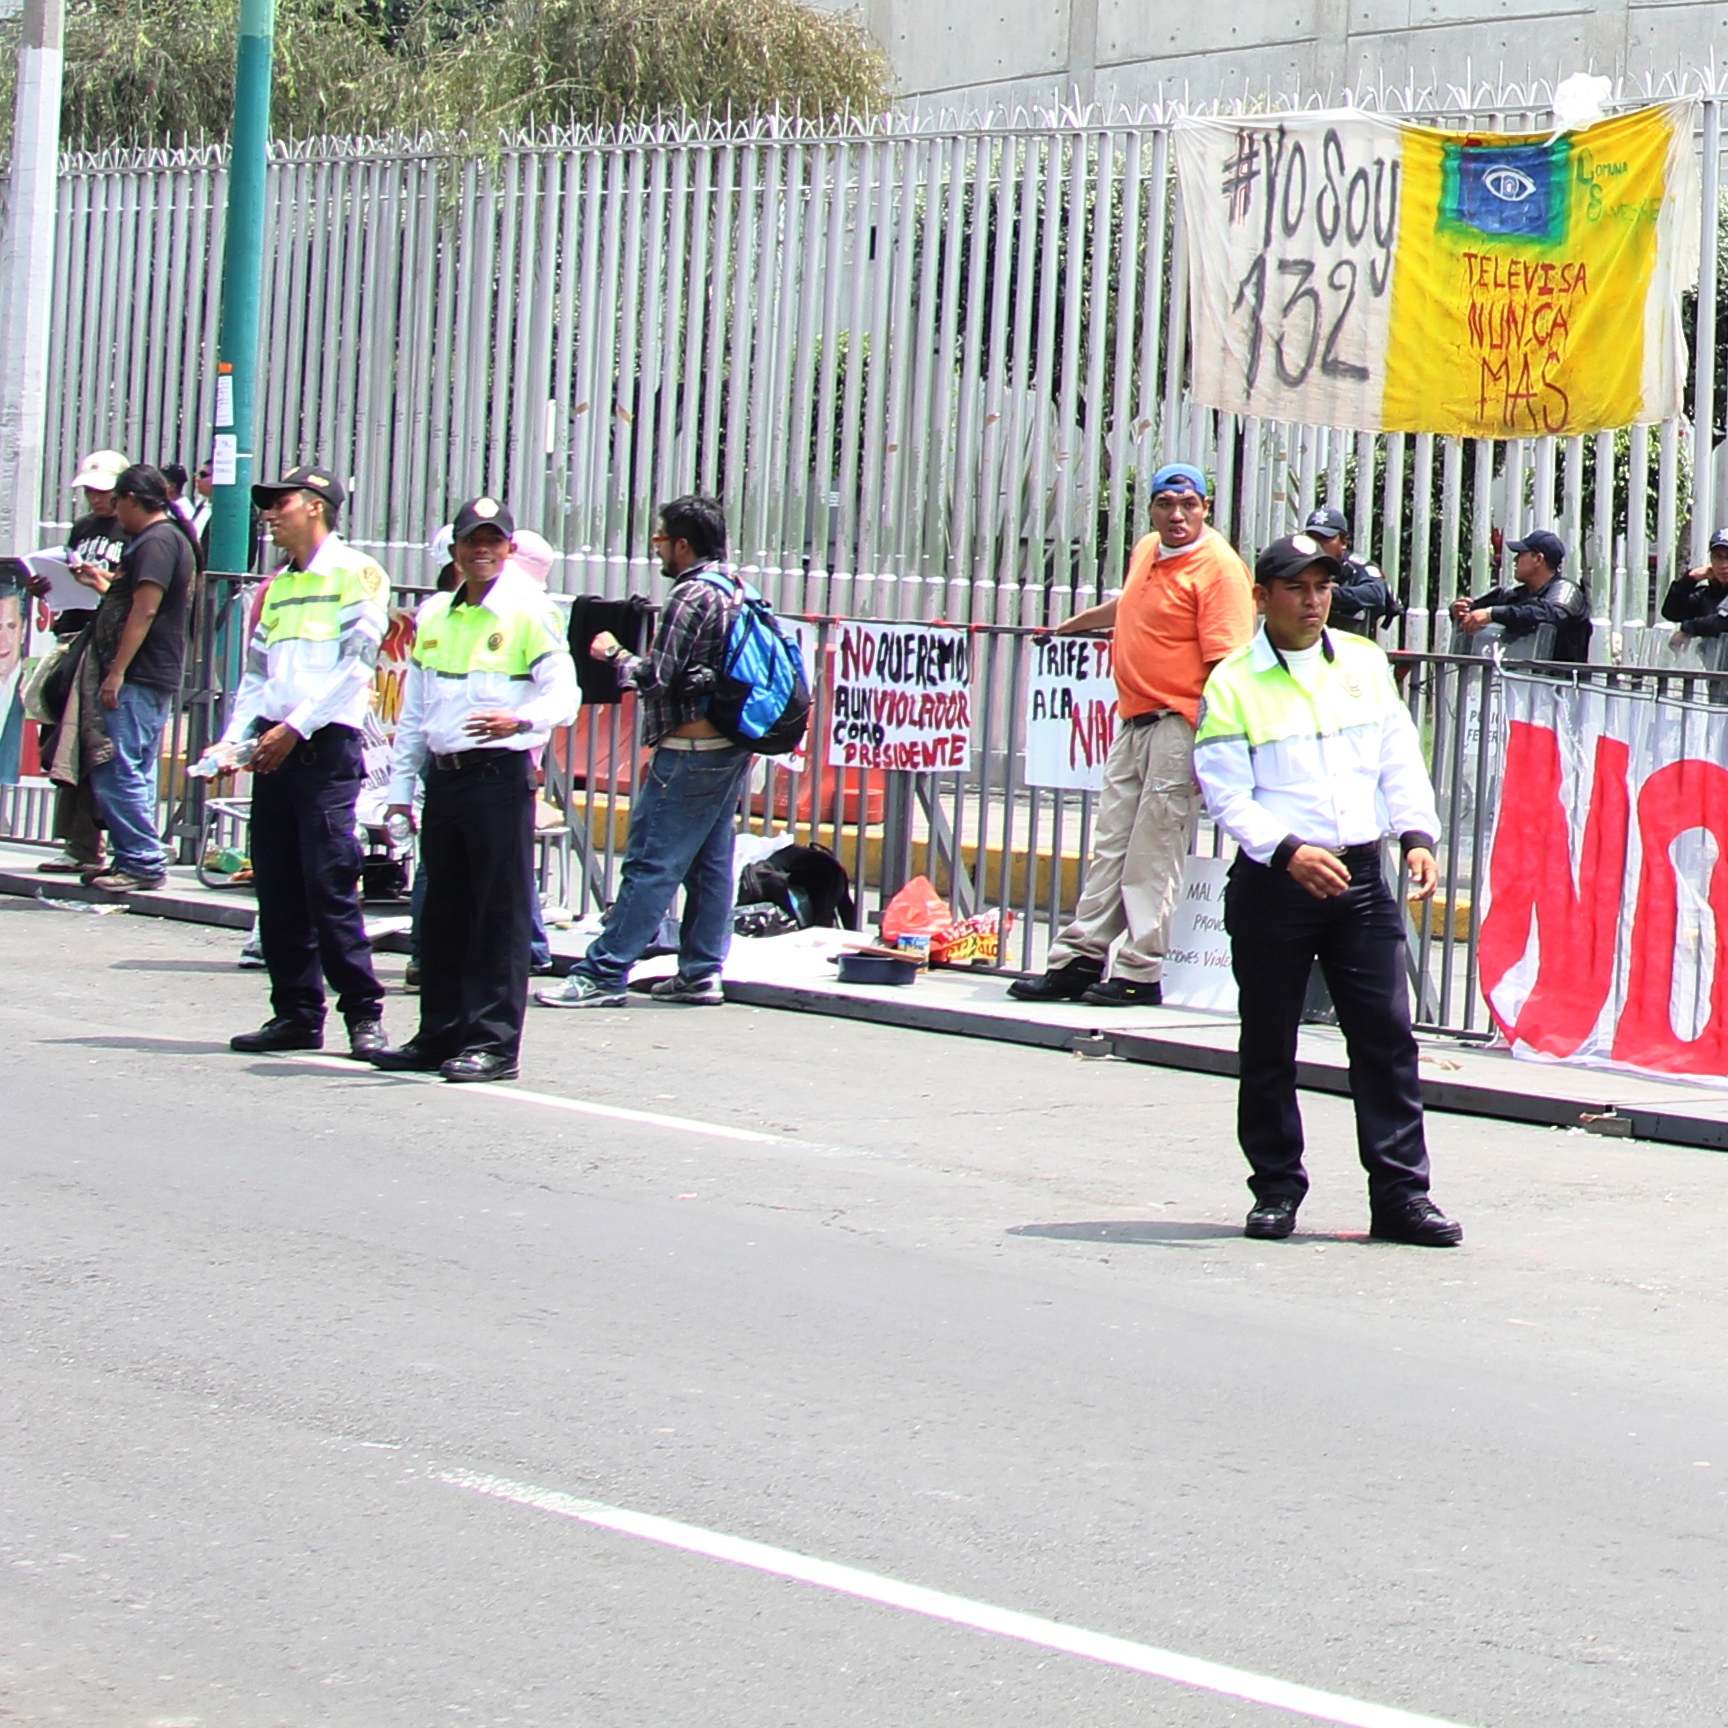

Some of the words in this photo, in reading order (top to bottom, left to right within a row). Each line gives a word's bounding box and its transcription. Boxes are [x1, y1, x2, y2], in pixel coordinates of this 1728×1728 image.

[1463, 252, 1588, 295] TELEVISA
[1231, 251, 1370, 401] 132
[1468, 300, 1569, 350] NUNCA
[840, 625, 875, 682] NO
[1034, 639, 1090, 681] TRIFE
[873, 686, 971, 731] VIOLADOR
[833, 720, 885, 747] COMO
[843, 733, 967, 769] PRESIDENTE
[1186, 882, 1211, 901] MAL
